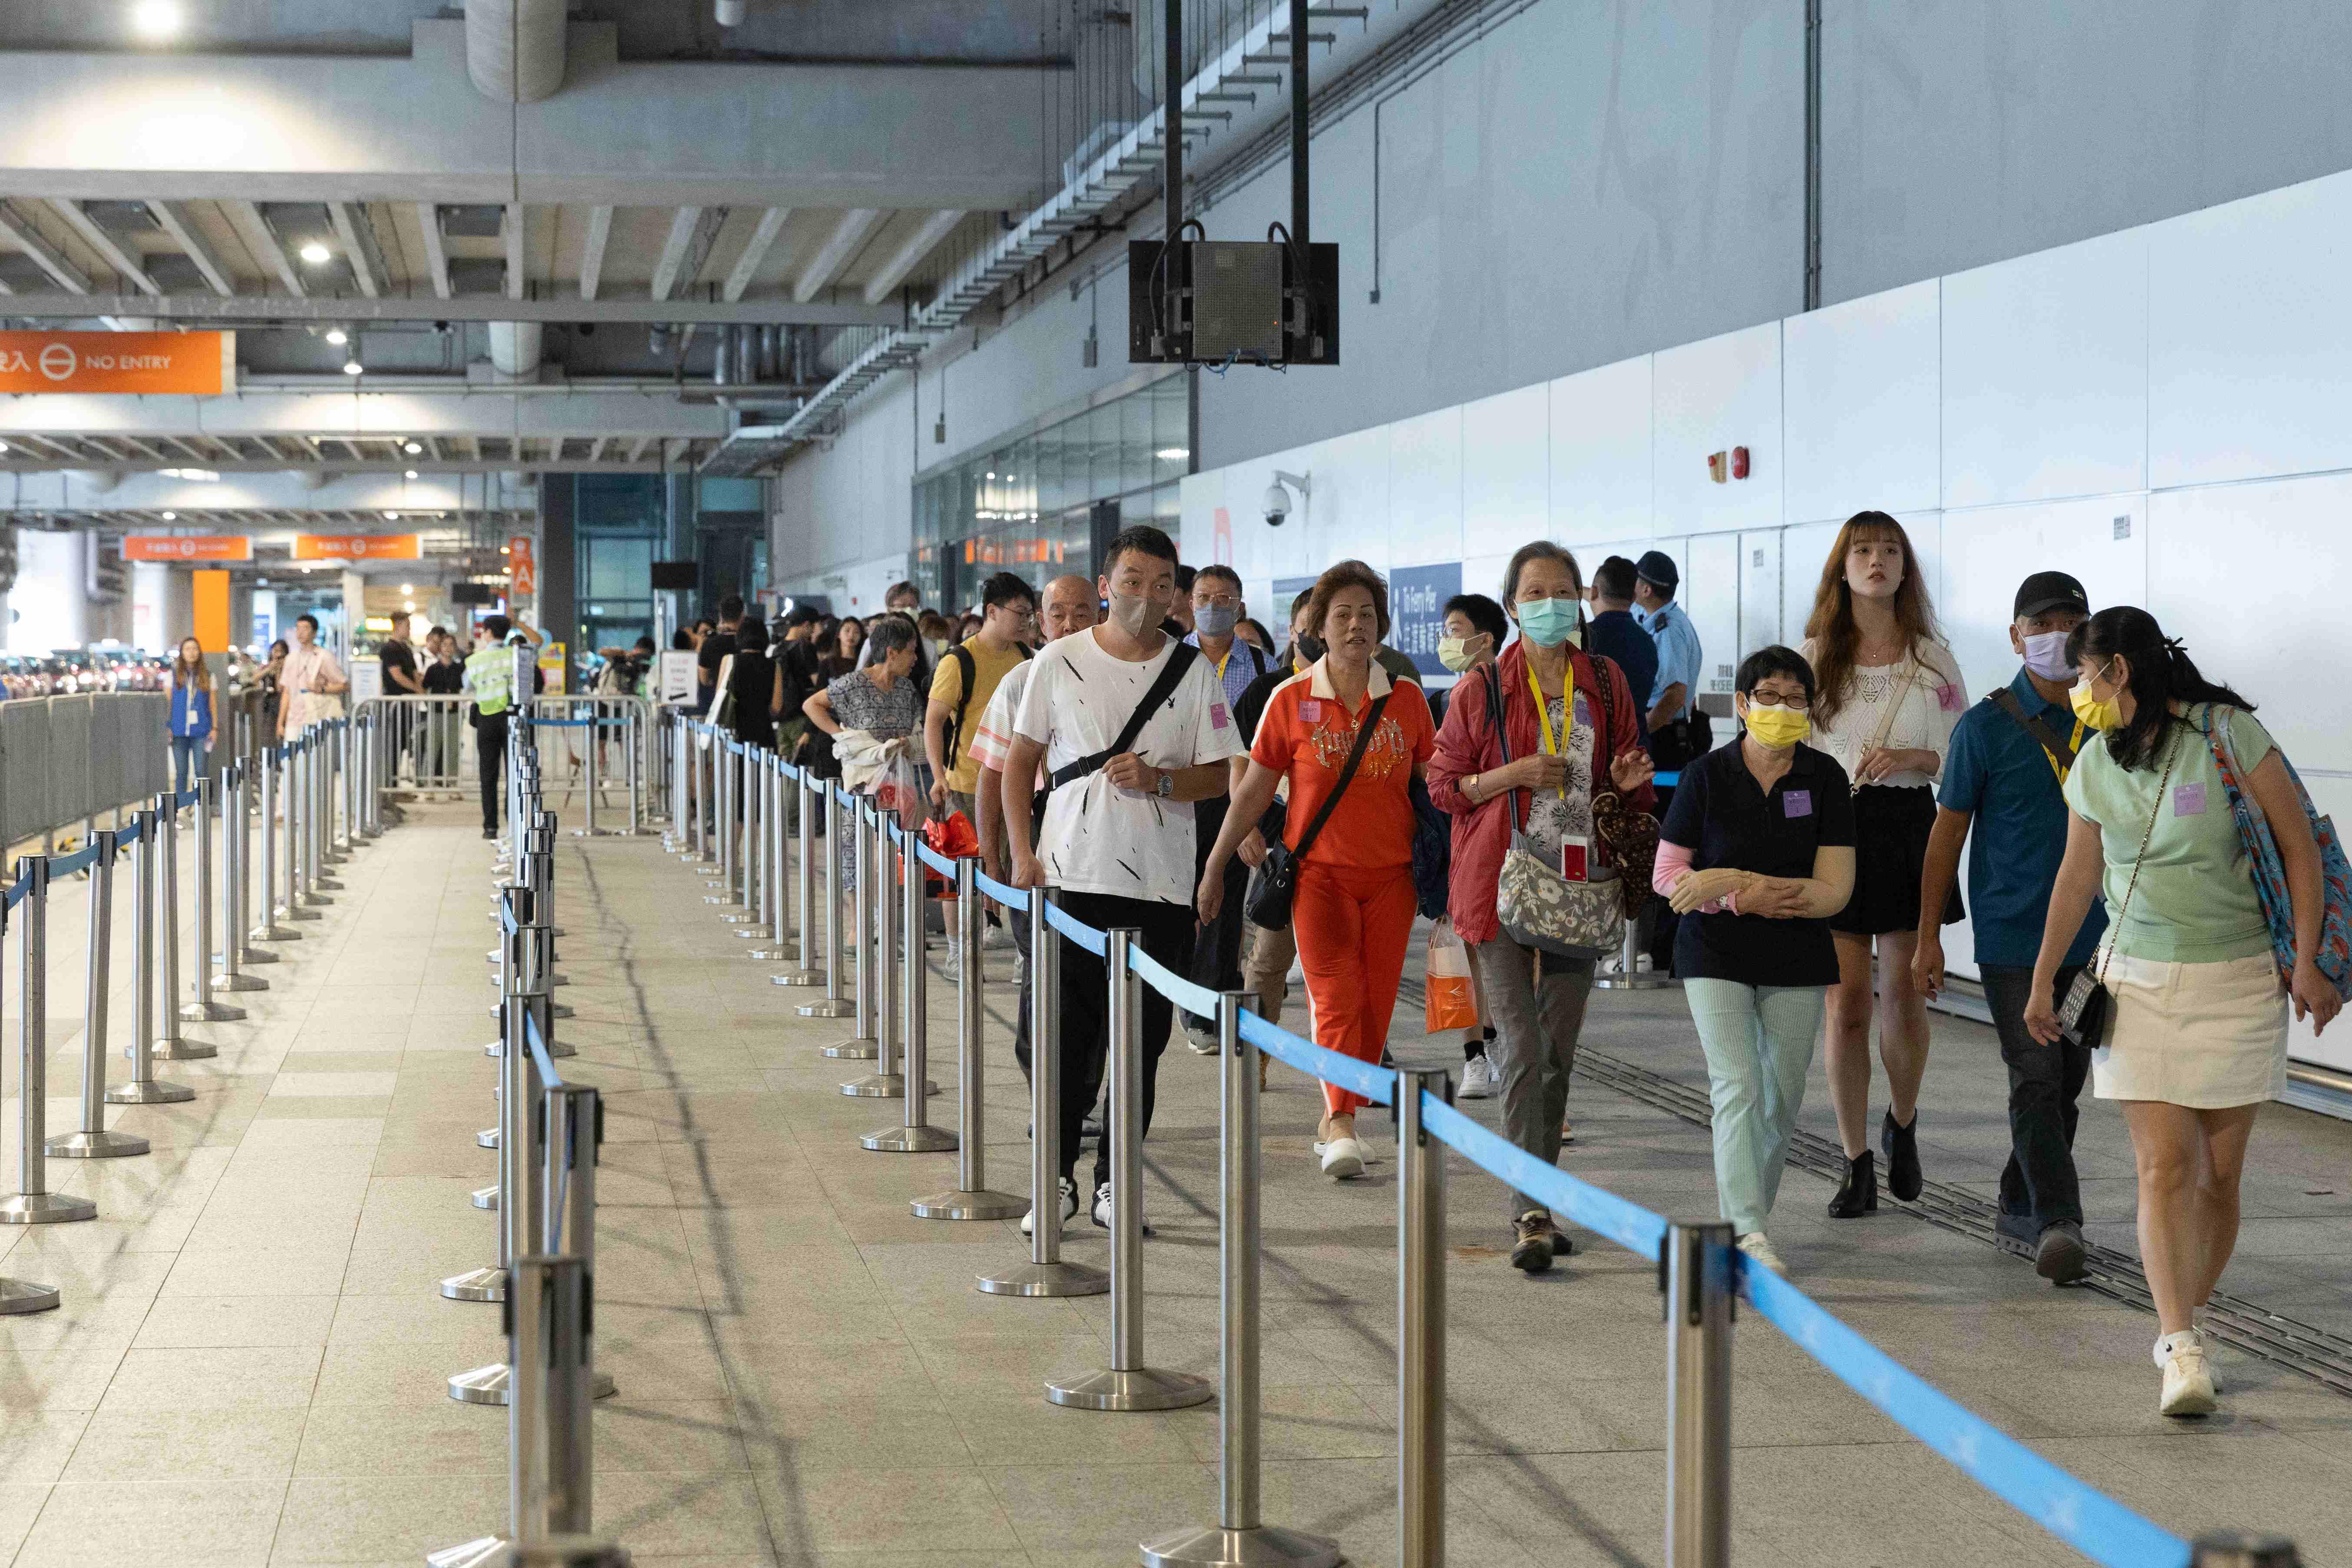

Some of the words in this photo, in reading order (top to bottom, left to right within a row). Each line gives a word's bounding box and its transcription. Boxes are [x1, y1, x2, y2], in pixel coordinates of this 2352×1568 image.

[86, 355, 114, 370] NO
[119, 355, 171, 369] ENTRY
[514, 564, 533, 590] A
